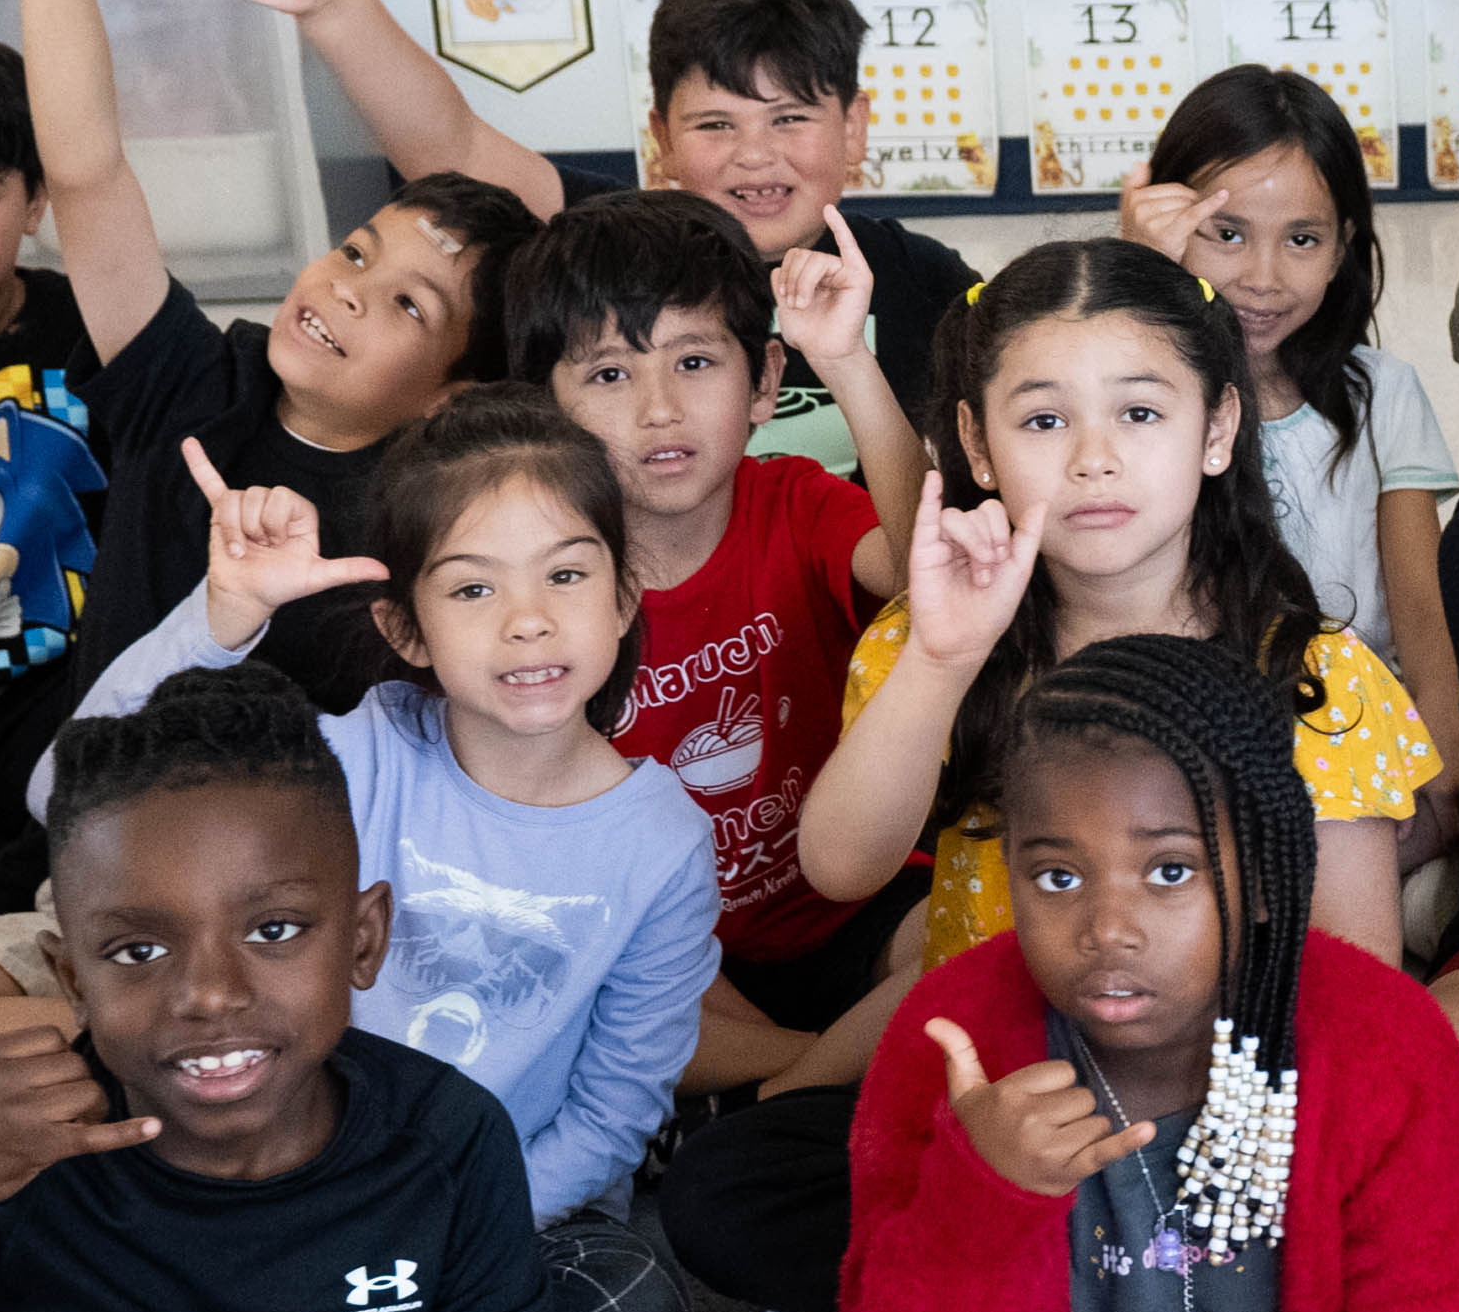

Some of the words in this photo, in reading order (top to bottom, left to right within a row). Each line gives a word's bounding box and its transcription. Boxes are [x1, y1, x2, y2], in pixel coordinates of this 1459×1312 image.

[878, 5, 937, 47] 12
[1080, 2, 1139, 45] 13
[1281, 0, 1337, 41] 14
[1102, 1243, 1134, 1277] it's
